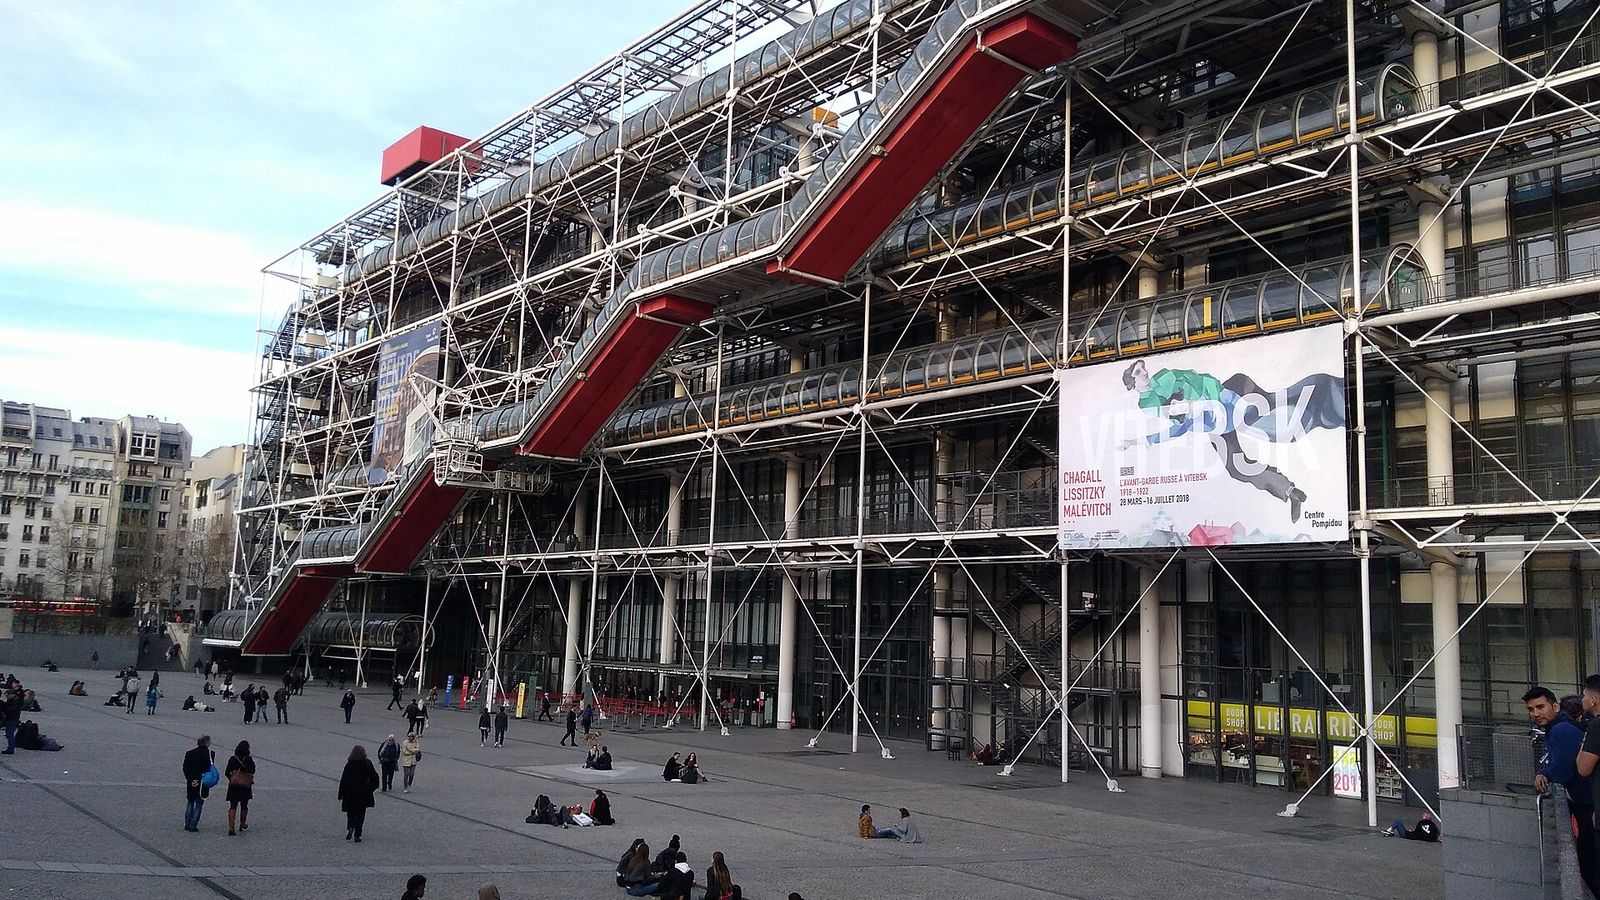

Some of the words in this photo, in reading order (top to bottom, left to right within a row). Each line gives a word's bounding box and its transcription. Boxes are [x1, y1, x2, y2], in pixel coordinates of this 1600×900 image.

[1079, 384, 1320, 479] VITEBSK
[1063, 469, 1102, 485] CHAGALL
[1160, 474, 1178, 484] RUSSE
[1184, 472, 1208, 482] VITEBSK
[1063, 486, 1106, 501] LISSITZKY
[1119, 498, 1127, 506] 28
[1127, 497, 1143, 506] MARS
[1146, 496, 1153, 505] 16
[1154, 495, 1175, 504] JUILLET
[1176, 494, 1190, 503] 2018
[1063, 501, 1112, 518] MALÉVITCH
[1304, 511, 1325, 519] Centre
[1312, 518, 1343, 529] Pompidou
[1226, 707, 1245, 718] BOOK
[1226, 718, 1245, 728] SHOP
[1373, 719, 1394, 730] OOK
[1334, 773, 1361, 793] 201
